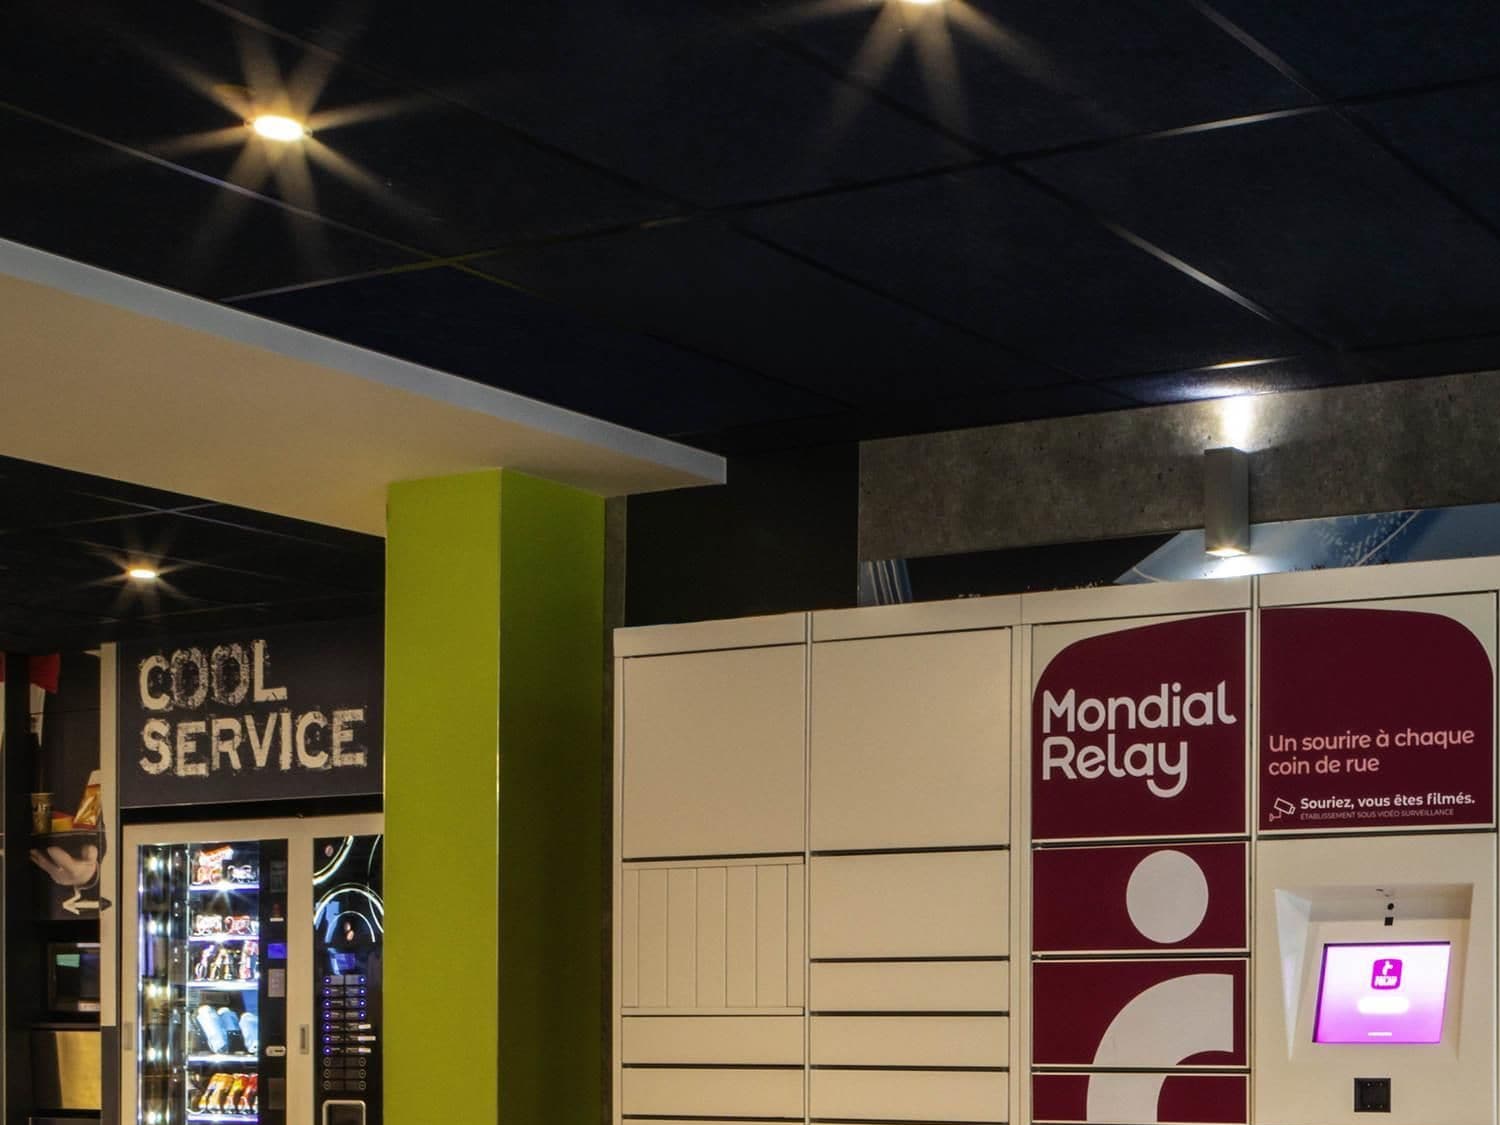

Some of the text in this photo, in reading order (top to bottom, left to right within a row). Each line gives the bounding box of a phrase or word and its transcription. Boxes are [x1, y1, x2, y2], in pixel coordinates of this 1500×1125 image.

[138, 639, 288, 712] COOL
[1042, 680, 1237, 733] Mondial
[138, 708, 367, 778] SERVICE
[1268, 727, 1475, 753] Un sourire à chaque
[1042, 733, 1189, 798] Relay
[1268, 755, 1380, 776] coin de rue
[1300, 791, 1476, 810] Souriez, vous êtes filmés.
[1300, 808, 1454, 820] ÉTABLISSEMENT SOUS VIDÉO SURVEILLANCE
